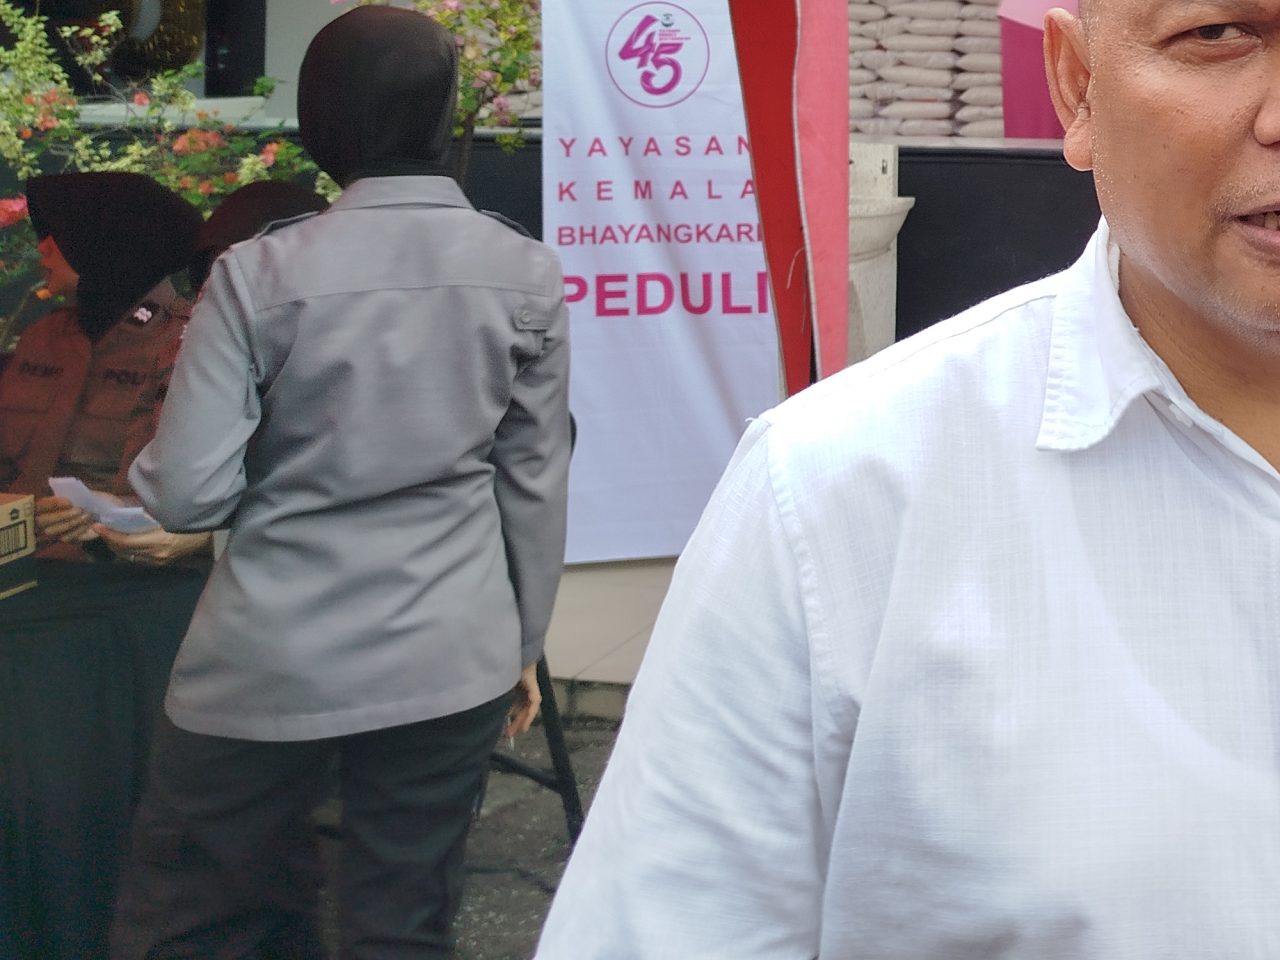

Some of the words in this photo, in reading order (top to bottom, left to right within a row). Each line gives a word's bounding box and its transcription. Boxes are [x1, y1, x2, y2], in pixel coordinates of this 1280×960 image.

[618, 14, 684, 96] 45
[559, 135, 750, 157] YAYASAN
[558, 179, 755, 201] KEMALA
[557, 223, 763, 246] BHAYANGKARI
[563, 272, 769, 317] PEDULI
